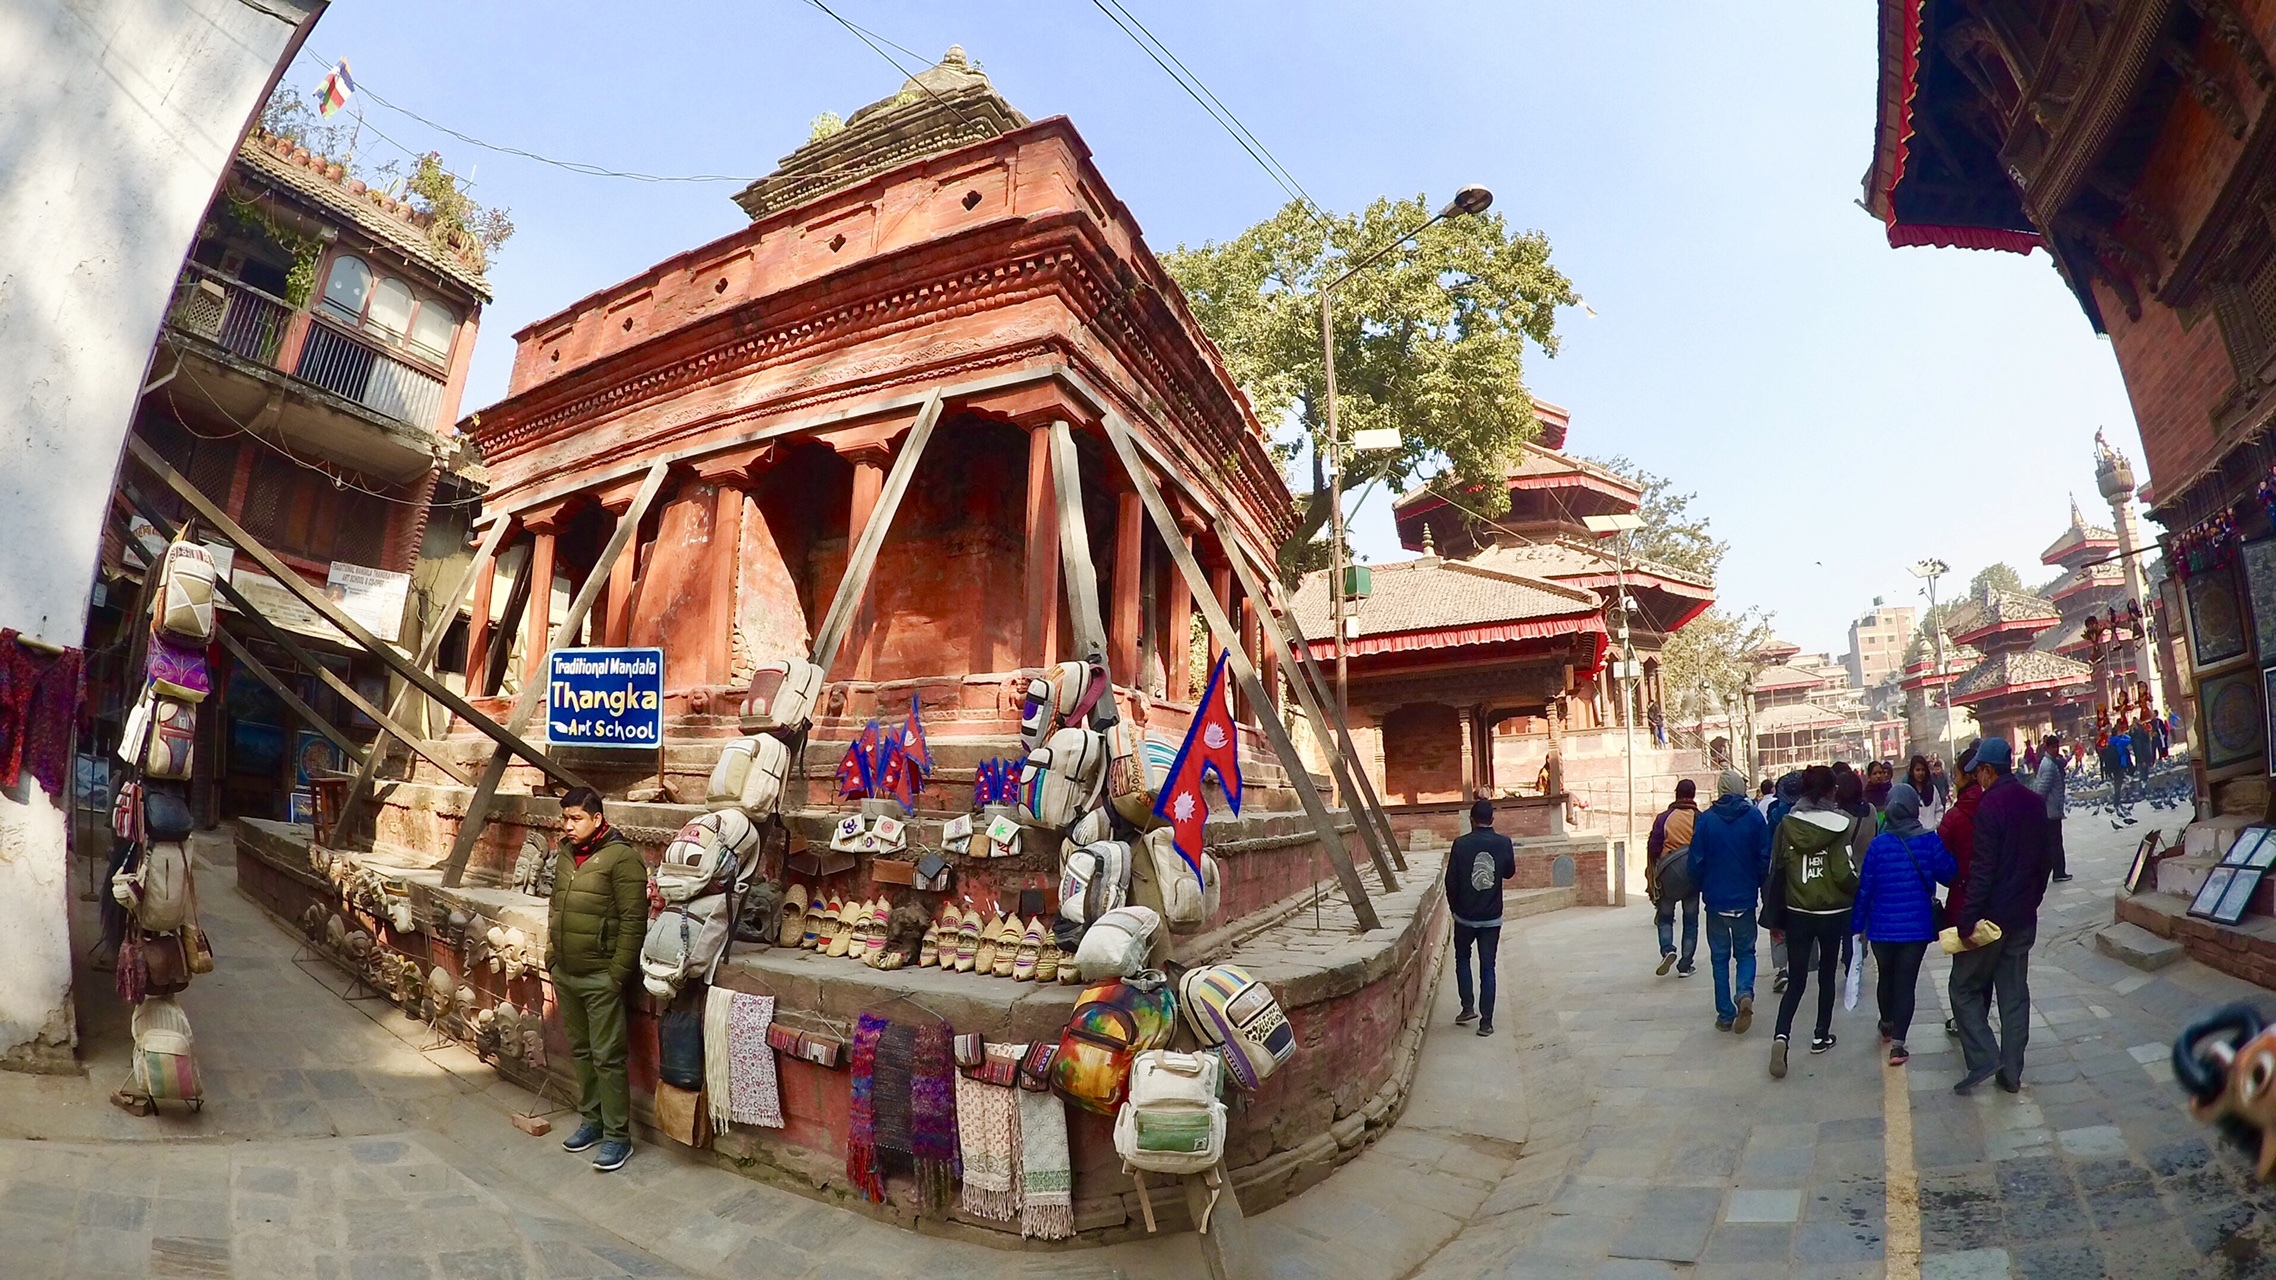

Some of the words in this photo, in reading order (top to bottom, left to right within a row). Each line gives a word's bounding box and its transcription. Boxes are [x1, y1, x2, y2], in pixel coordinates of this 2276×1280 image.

[554, 658, 609, 679] Traditional
[610, 658, 656, 678] Mandala
[552, 682, 658, 717] Thangka
[568, 718, 592, 736] Art
[594, 719, 655, 740] School
